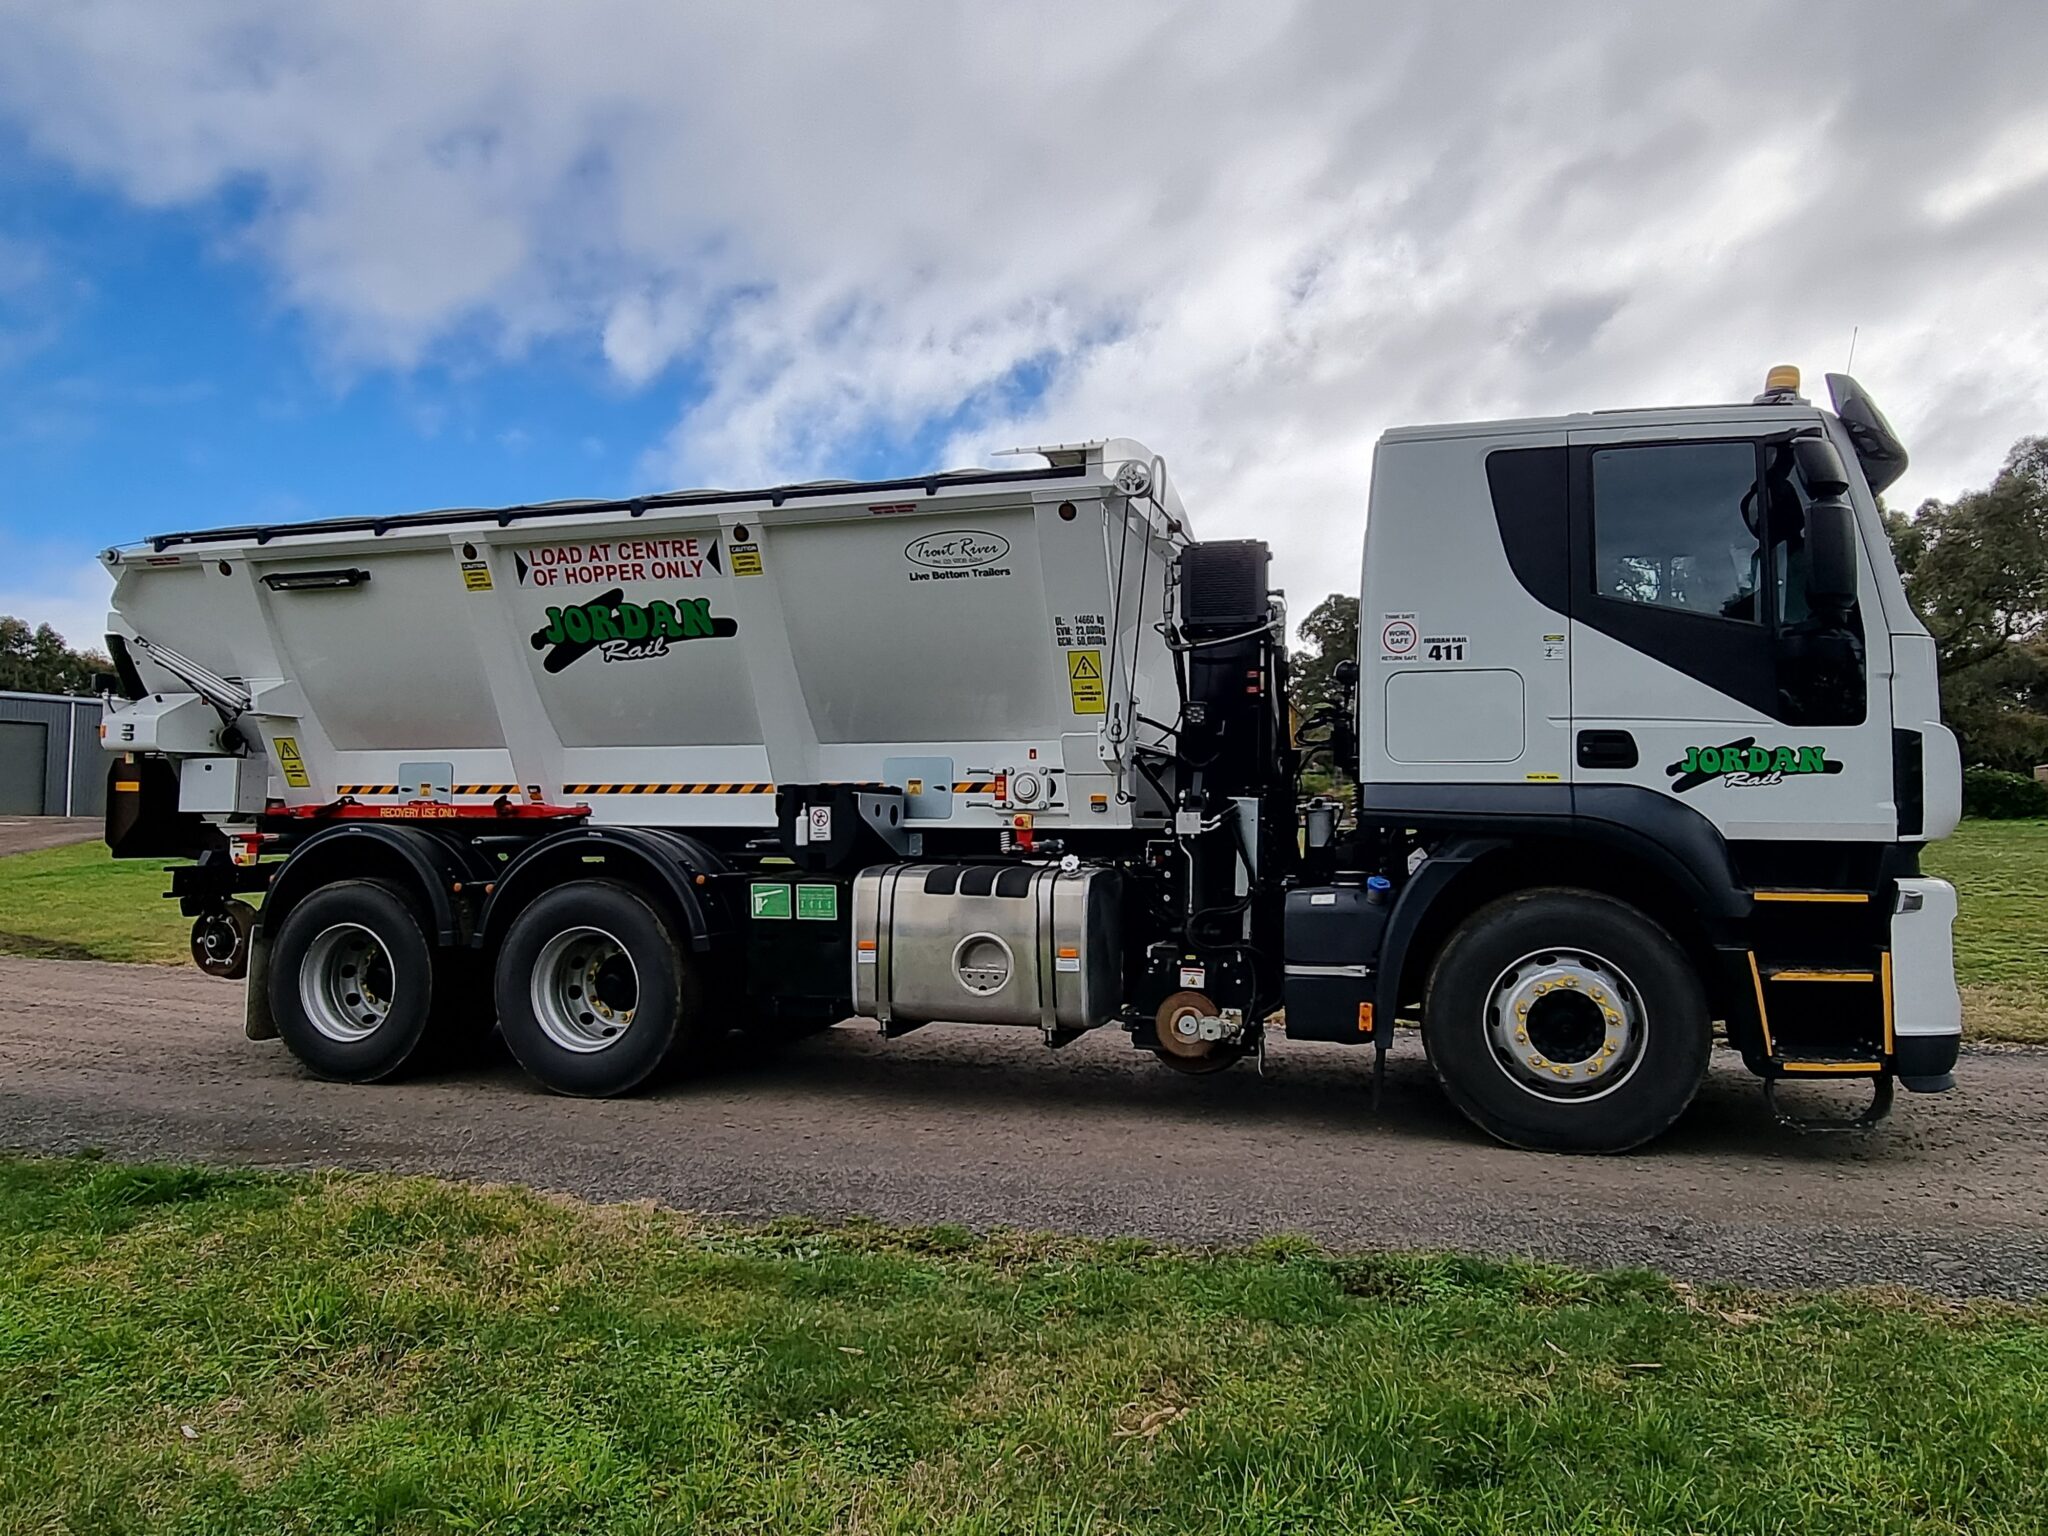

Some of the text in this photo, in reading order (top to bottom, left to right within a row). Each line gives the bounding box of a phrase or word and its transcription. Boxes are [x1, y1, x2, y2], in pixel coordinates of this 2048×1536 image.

[530, 539, 699, 566] LOAD AT CENTRE
[916, 538, 998, 557] Trout River
[533, 560, 703, 586] OF HOPPER ONLY
[909, 568, 1011, 581] Live Bottom Trailers
[546, 598, 714, 644] JORDAN
[601, 636, 667, 661] Rail
[1428, 645, 1463, 661] 411
[1681, 746, 1826, 774] JORDAN
[1725, 771, 1782, 787] Rail
[380, 807, 457, 818] RECOVERY USE ONLY
